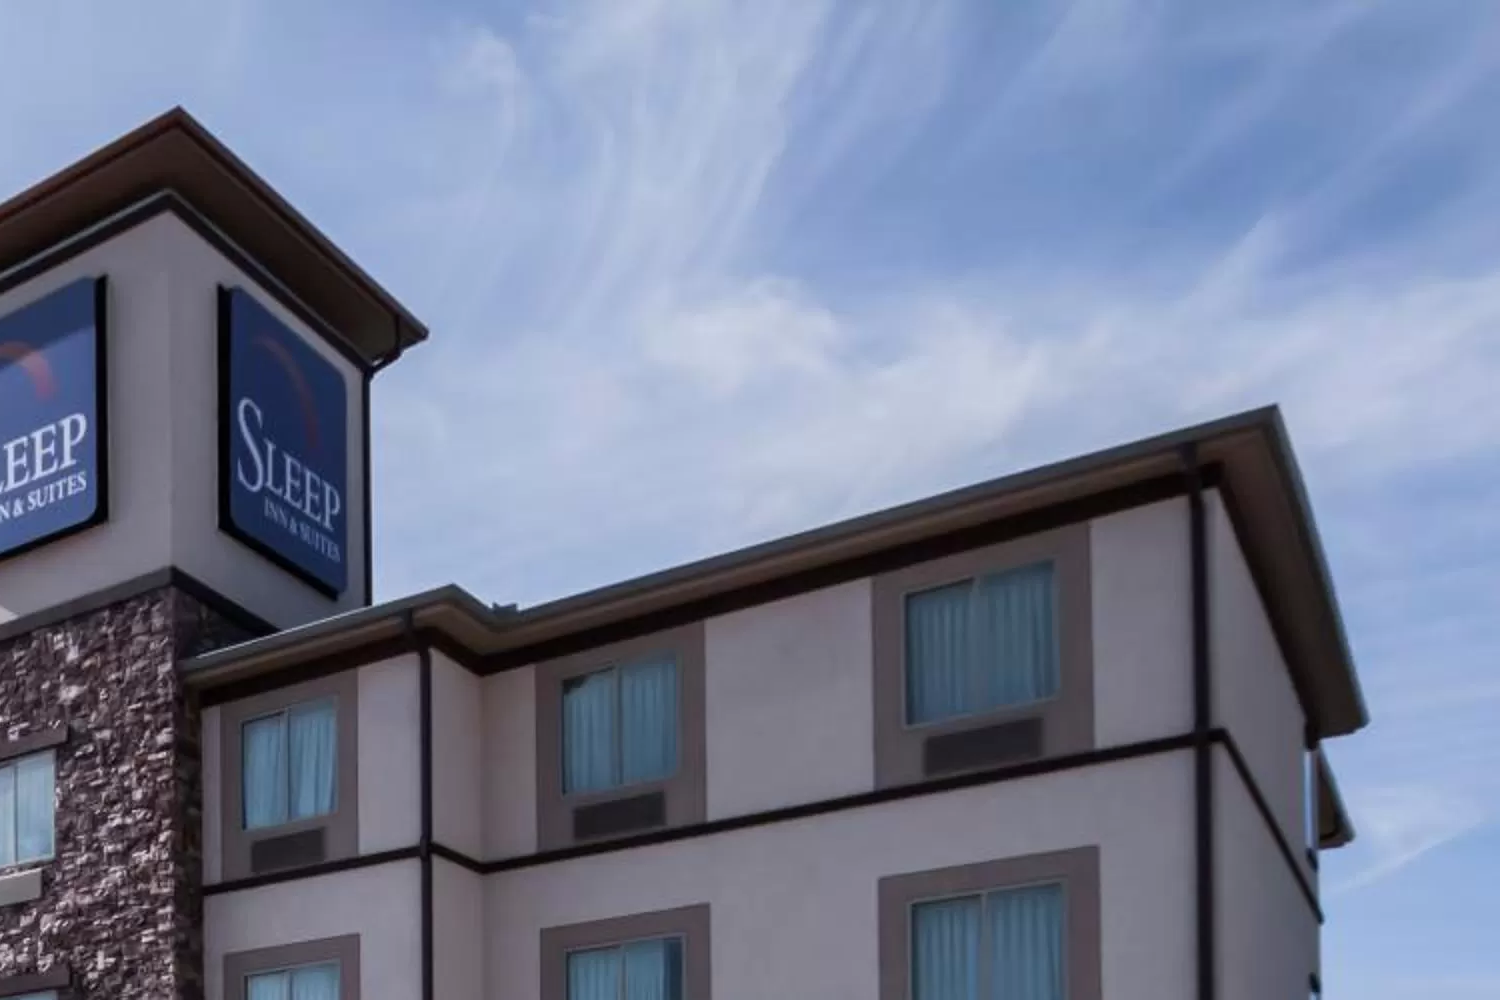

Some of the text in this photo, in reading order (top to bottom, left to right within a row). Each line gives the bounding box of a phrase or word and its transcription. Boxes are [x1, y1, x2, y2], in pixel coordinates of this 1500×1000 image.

[12, 497, 25, 517] &
[27, 471, 87, 511] SUITES
[237, 396, 340, 532] SLEEP
[264, 495, 288, 529] INN
[300, 521, 340, 562] SUITES
